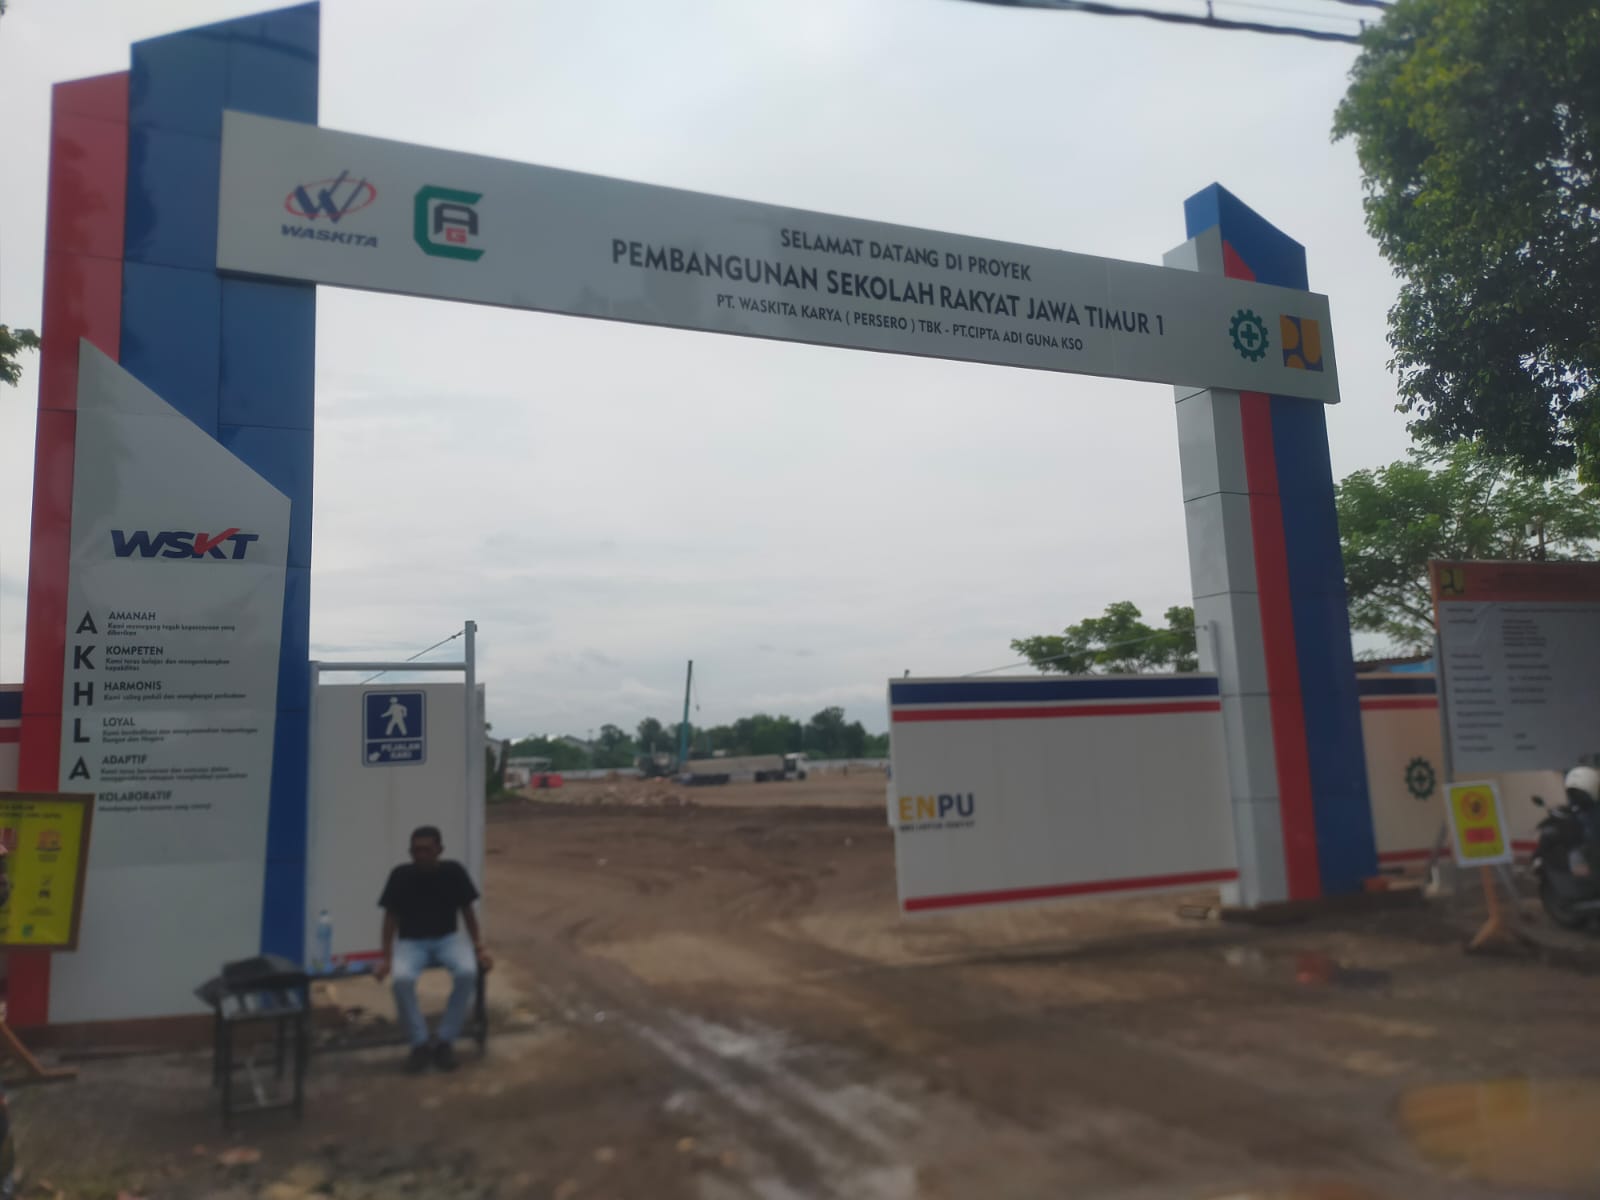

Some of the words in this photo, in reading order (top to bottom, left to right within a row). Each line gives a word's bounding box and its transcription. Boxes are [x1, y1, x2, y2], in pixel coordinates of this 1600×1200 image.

[281, 223, 379, 248] WASKITA
[780, 228, 864, 257] SELAMAT
[869, 241, 939, 268] DATANG
[945, 253, 962, 271] DI
[968, 256, 1032, 281] PROYEK
[611, 238, 818, 291] PEMBANGUNAN
[827, 269, 934, 305] SEKOLAH
[940, 285, 1020, 317] RAKYAT
[1026, 297, 1080, 326] JAWA
[1084, 305, 1150, 335] TIMUR
[1155, 314, 1165, 336] 1
[717, 293, 736, 309] PT.
[739, 297, 798, 317] WASKITA
[801, 305, 842, 323] KARYA
[854, 312, 907, 330] PERSERO
[918, 319, 942, 334] TBK
[1003, 329, 1022, 345] ADI
[1026, 333, 1059, 348] GUNA
[1061, 337, 1083, 351] KSO
[110, 527, 259, 560] WSKT
[108, 611, 156, 621] AMANAH
[106, 646, 164, 656] KOMPETEN
[104, 680, 162, 691] HARMONIS
[103, 716, 136, 727] LOYAL
[102, 754, 148, 765] ADAPTIF
[98, 789, 173, 801] KOLABORATIF
